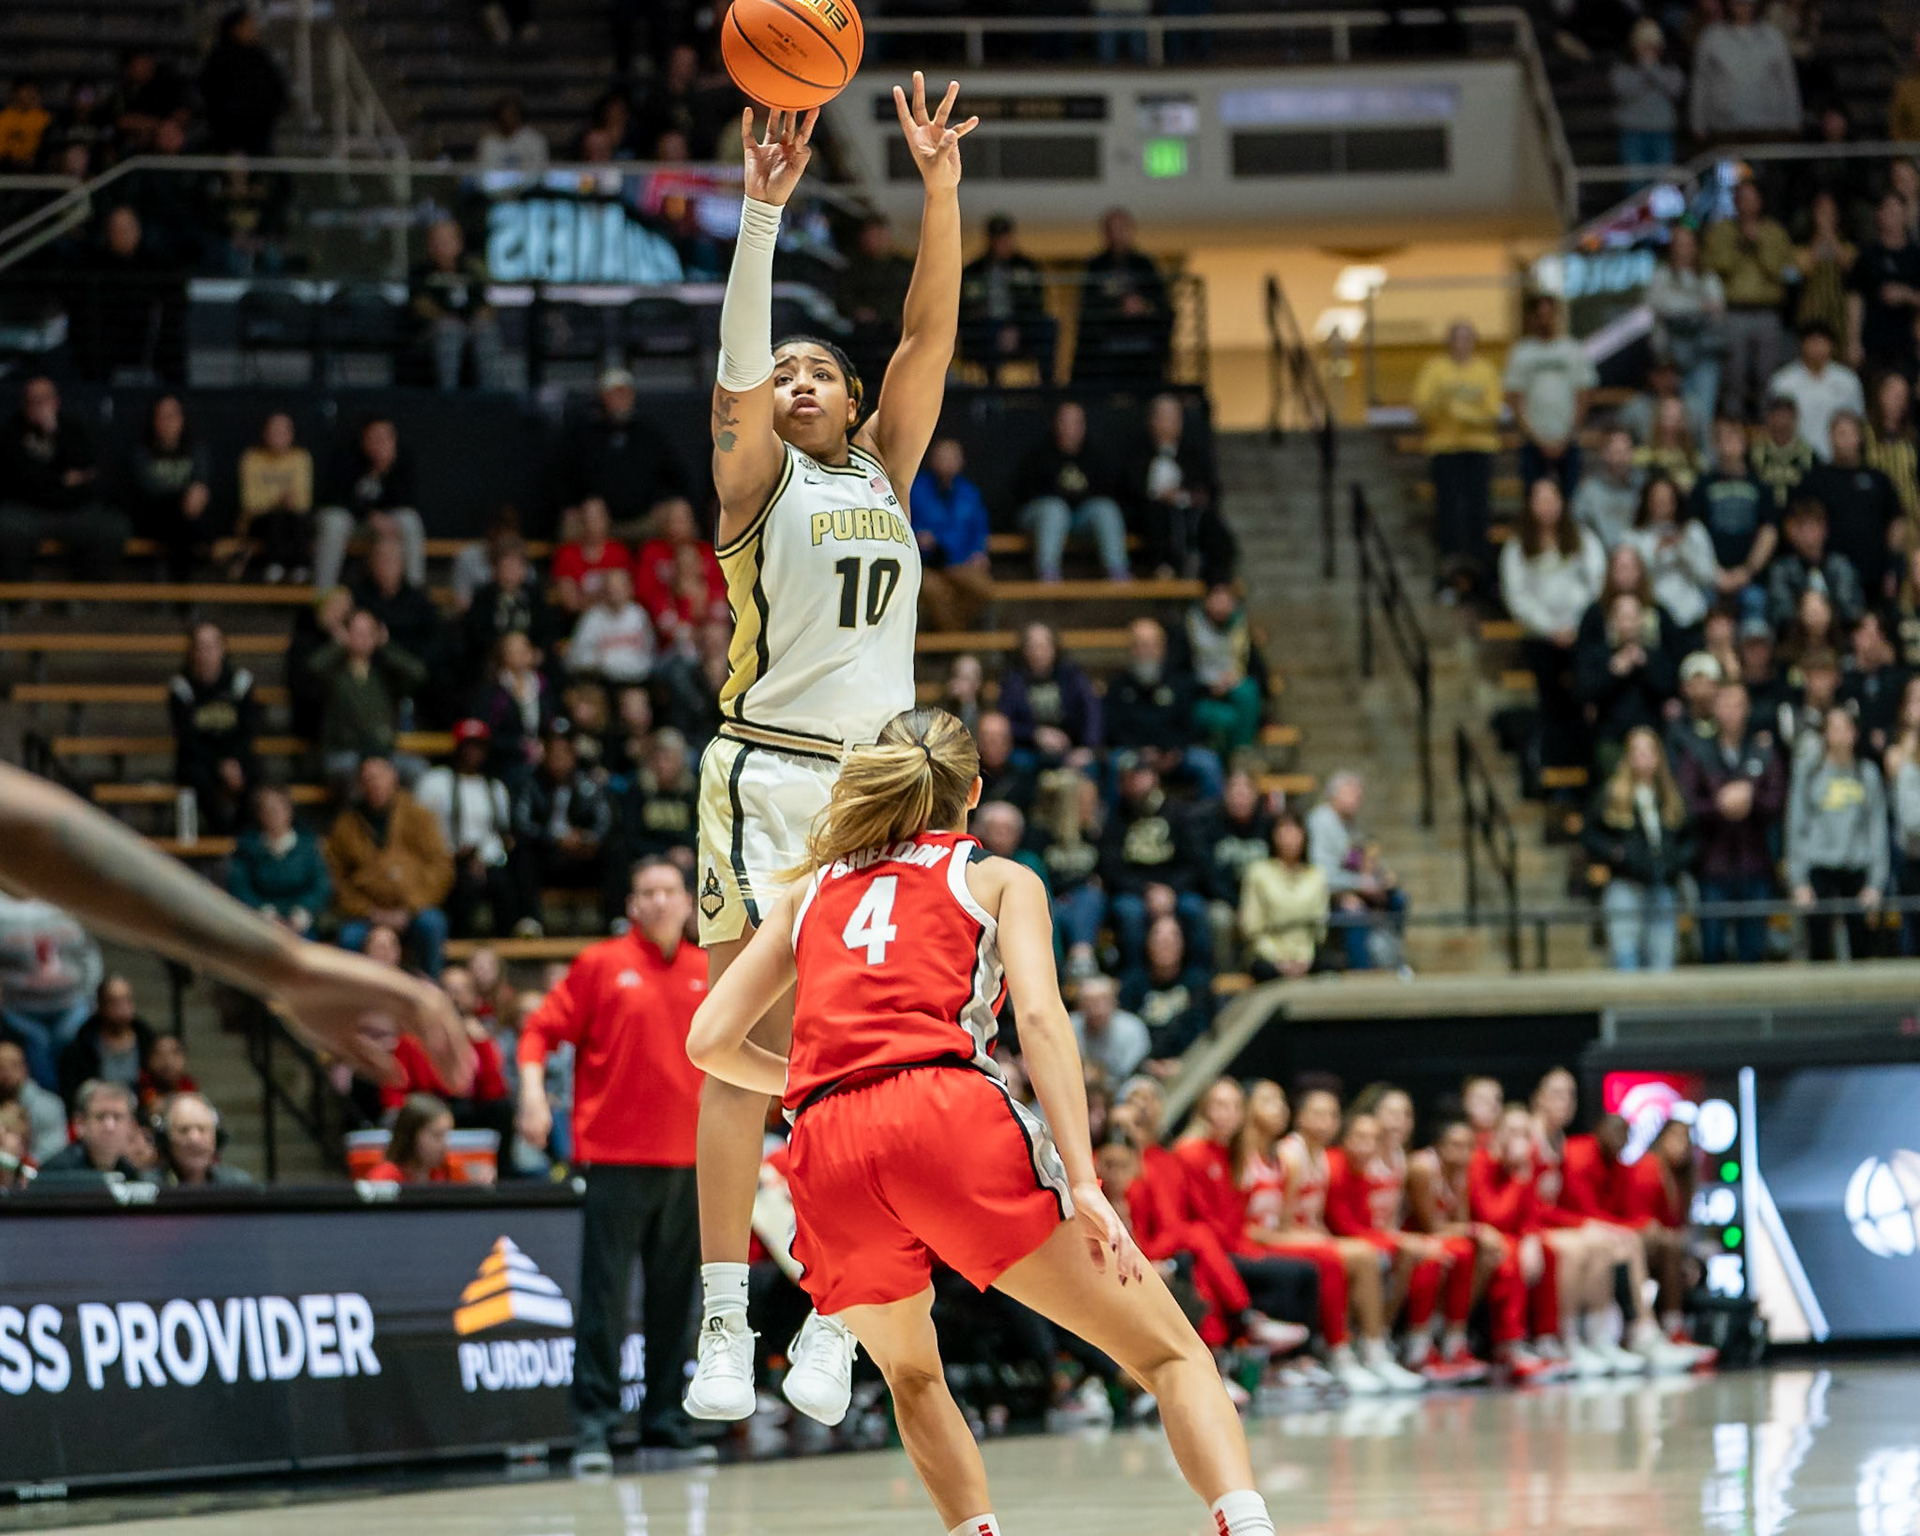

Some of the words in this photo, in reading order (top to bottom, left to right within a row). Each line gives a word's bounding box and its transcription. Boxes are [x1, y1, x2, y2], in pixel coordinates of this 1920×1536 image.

[811, 507, 911, 549] PURDUE
[835, 557, 901, 630] 10
[831, 841, 952, 880] SHELDON
[842, 875, 899, 966] 4
[78, 1293, 381, 1390] PROVIDER
